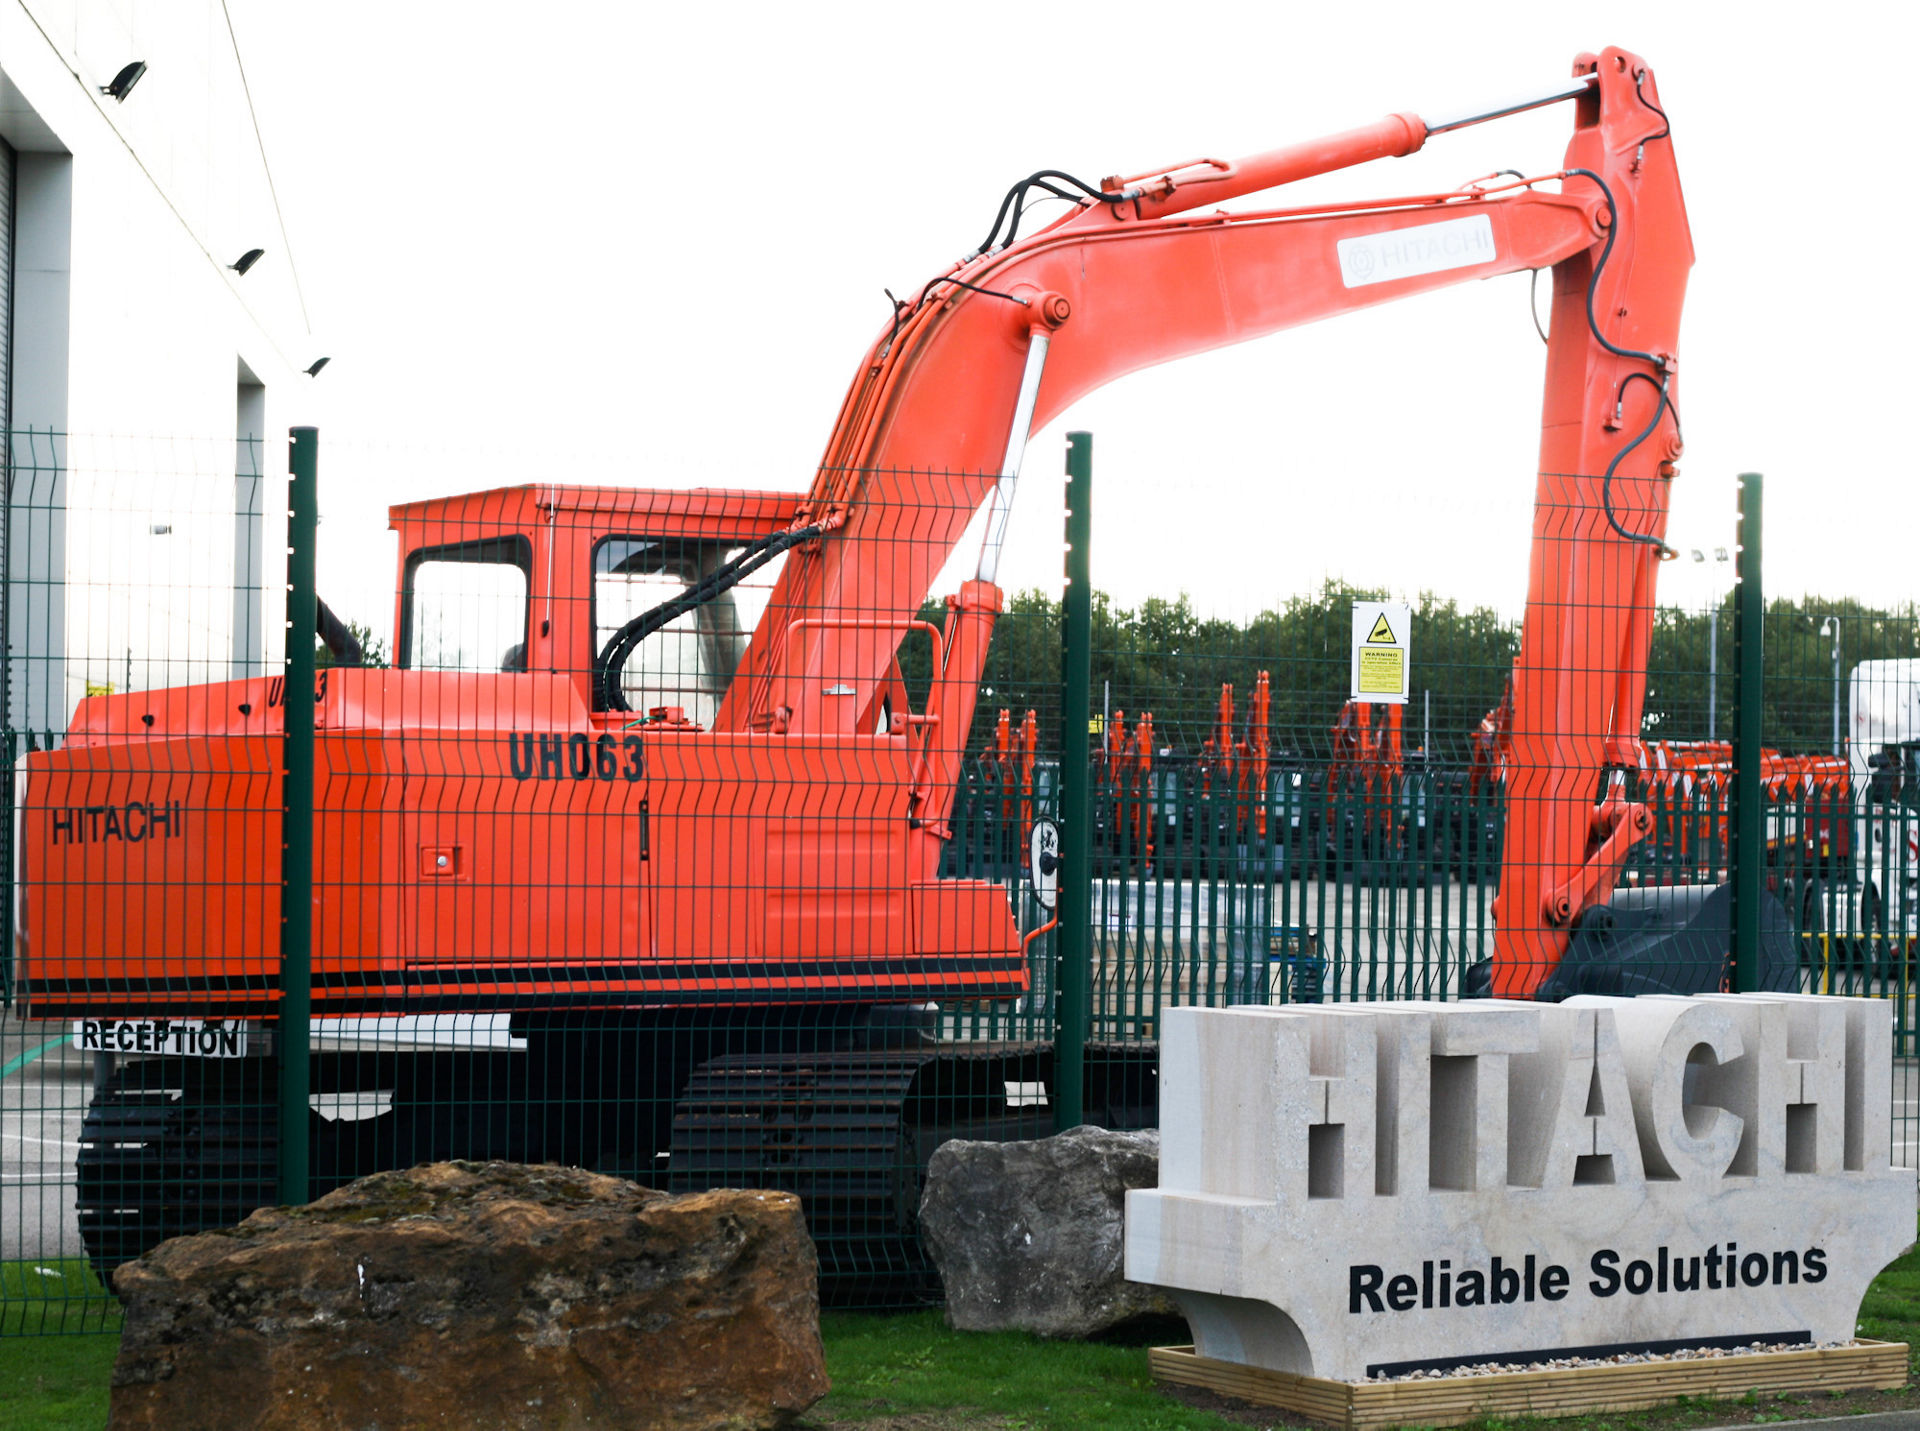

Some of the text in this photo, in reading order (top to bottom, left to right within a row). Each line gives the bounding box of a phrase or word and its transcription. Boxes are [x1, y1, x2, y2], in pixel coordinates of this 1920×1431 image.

[1381, 228, 1489, 268] HITACHI
[509, 732, 644, 783] UH063
[52, 799, 180, 845] HITACHI
[82, 1021, 239, 1056] RECEPTION
[1272, 996, 1893, 1200] HITACHI
[1349, 1242, 1828, 1314] Reliable Solutions
